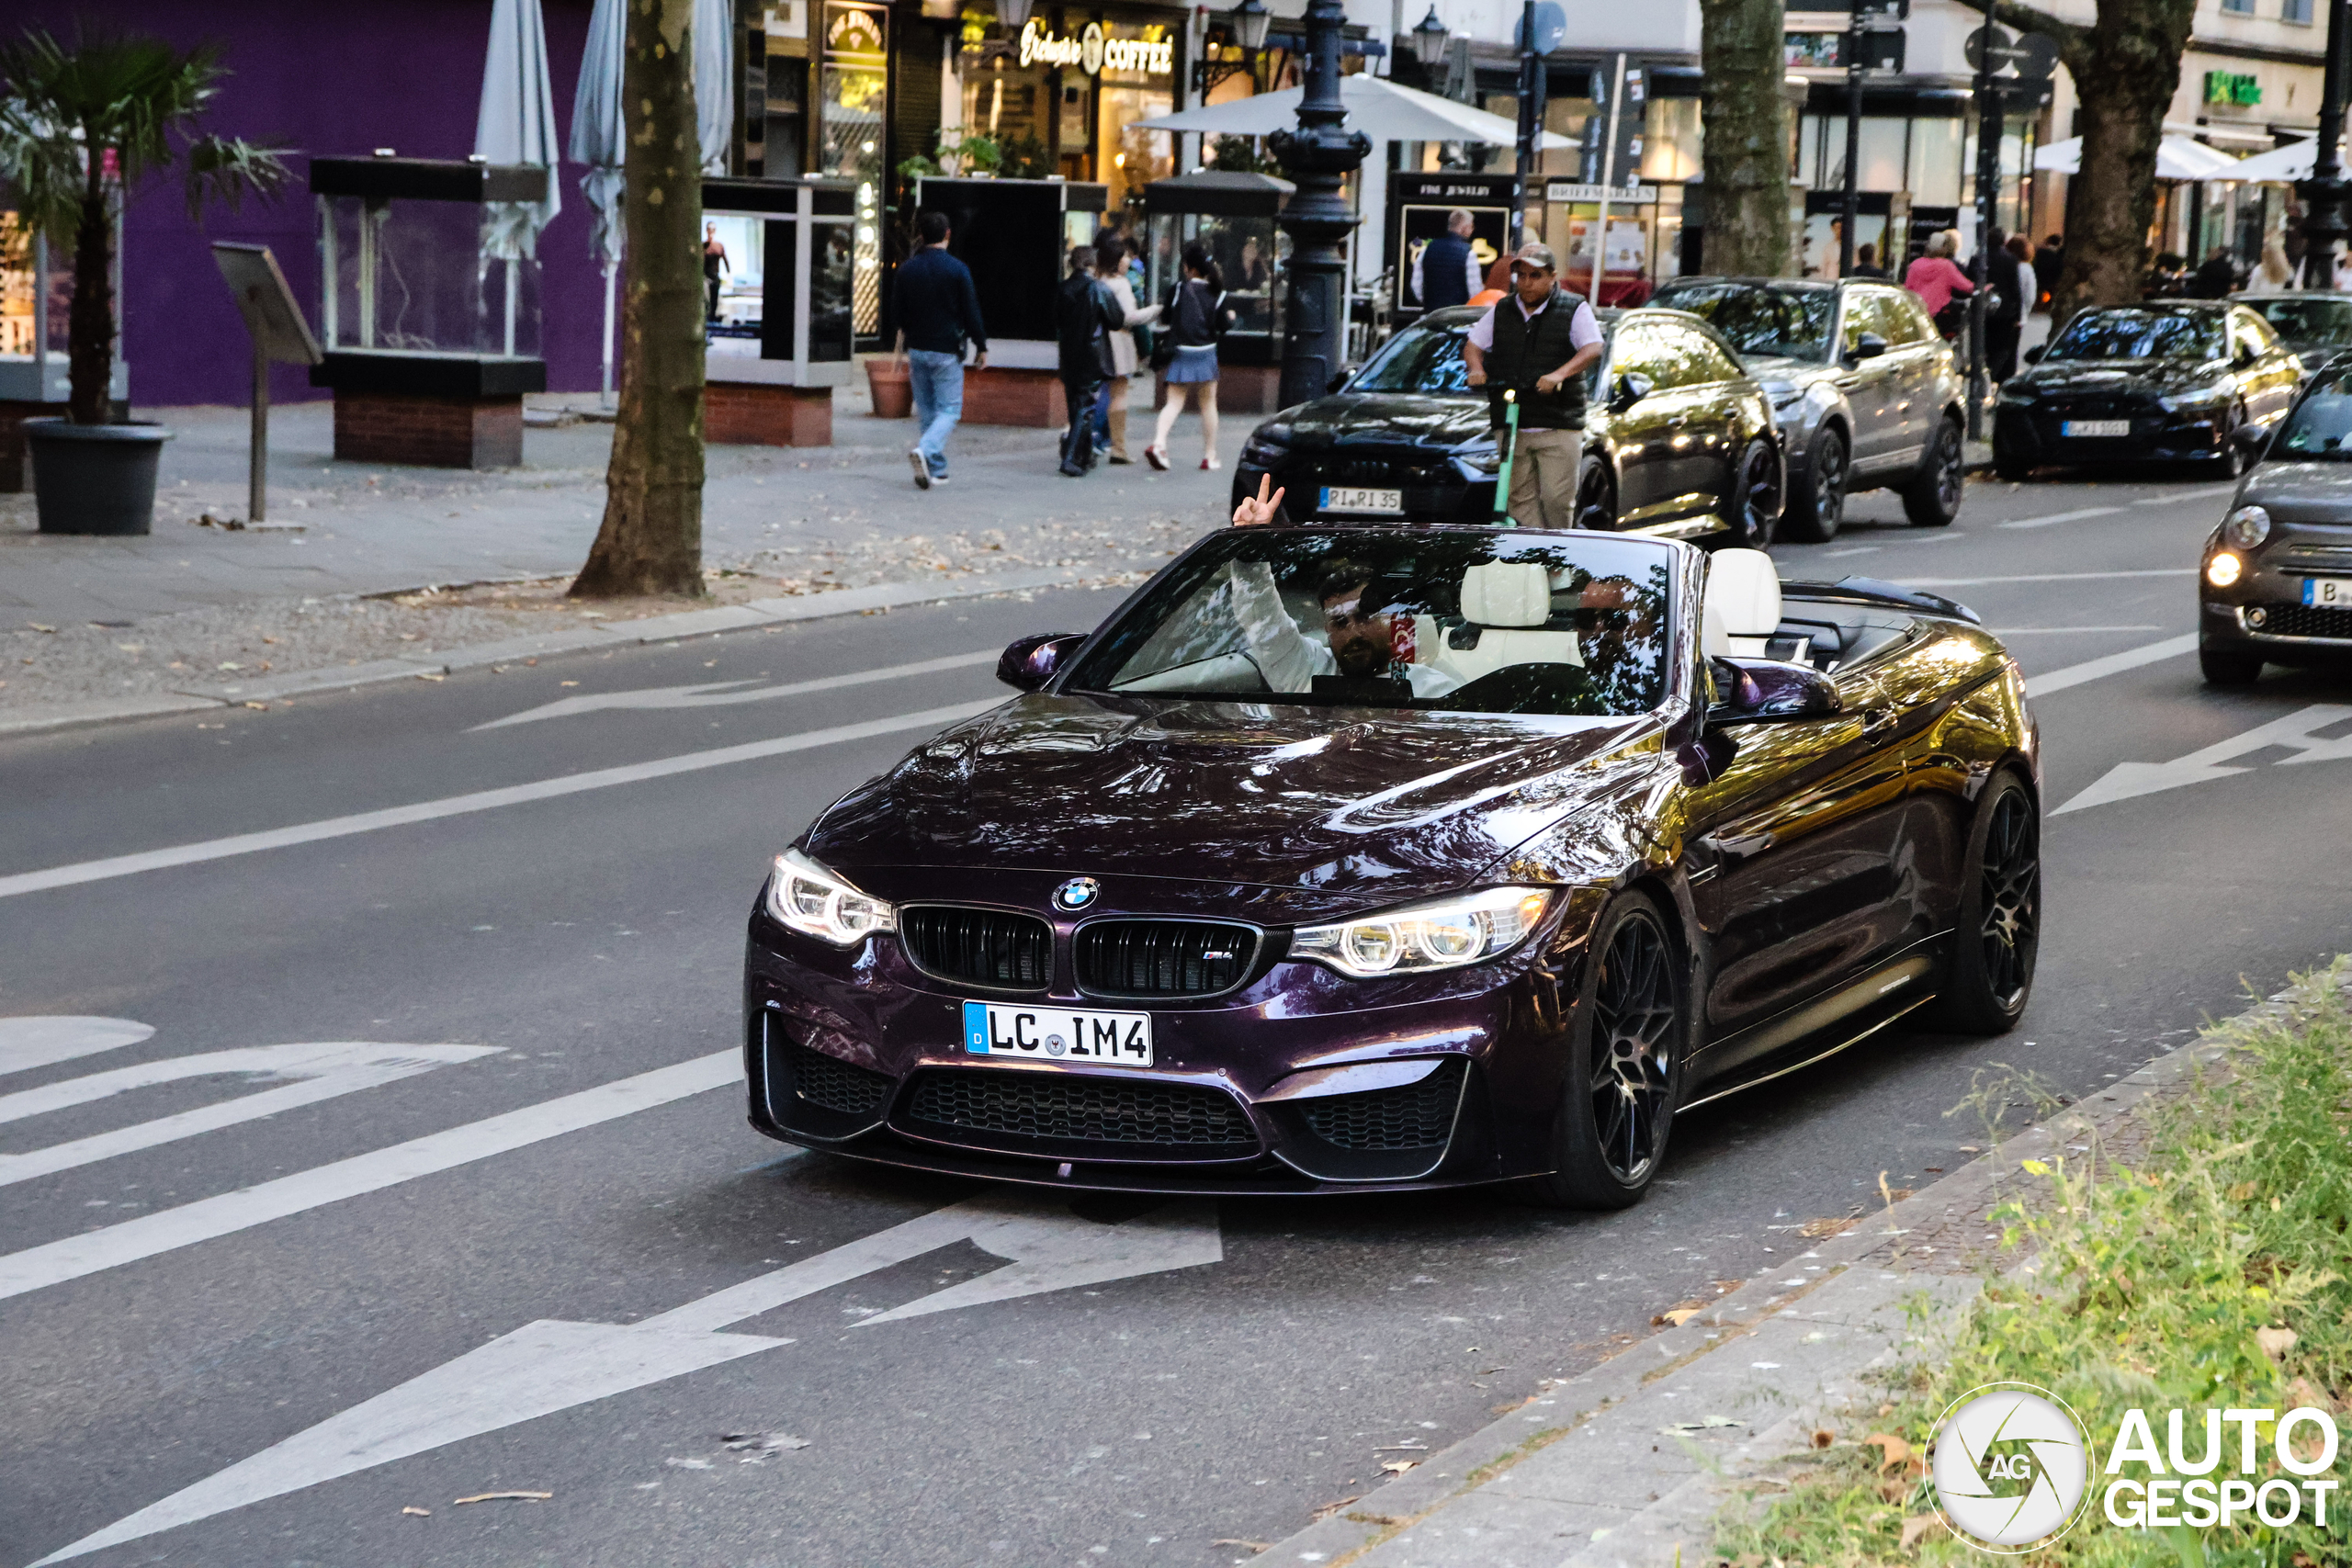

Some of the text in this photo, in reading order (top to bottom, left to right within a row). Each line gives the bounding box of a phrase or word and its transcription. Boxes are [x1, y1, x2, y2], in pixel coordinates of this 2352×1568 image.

[1020, 21, 1173, 73] Exclusive COFFEE
[1329, 490, 1397, 508] RI RI 35
[2324, 582, 2336, 602] B
[973, 1032, 982, 1044] D
[989, 1011, 1147, 1058] LC IM4
